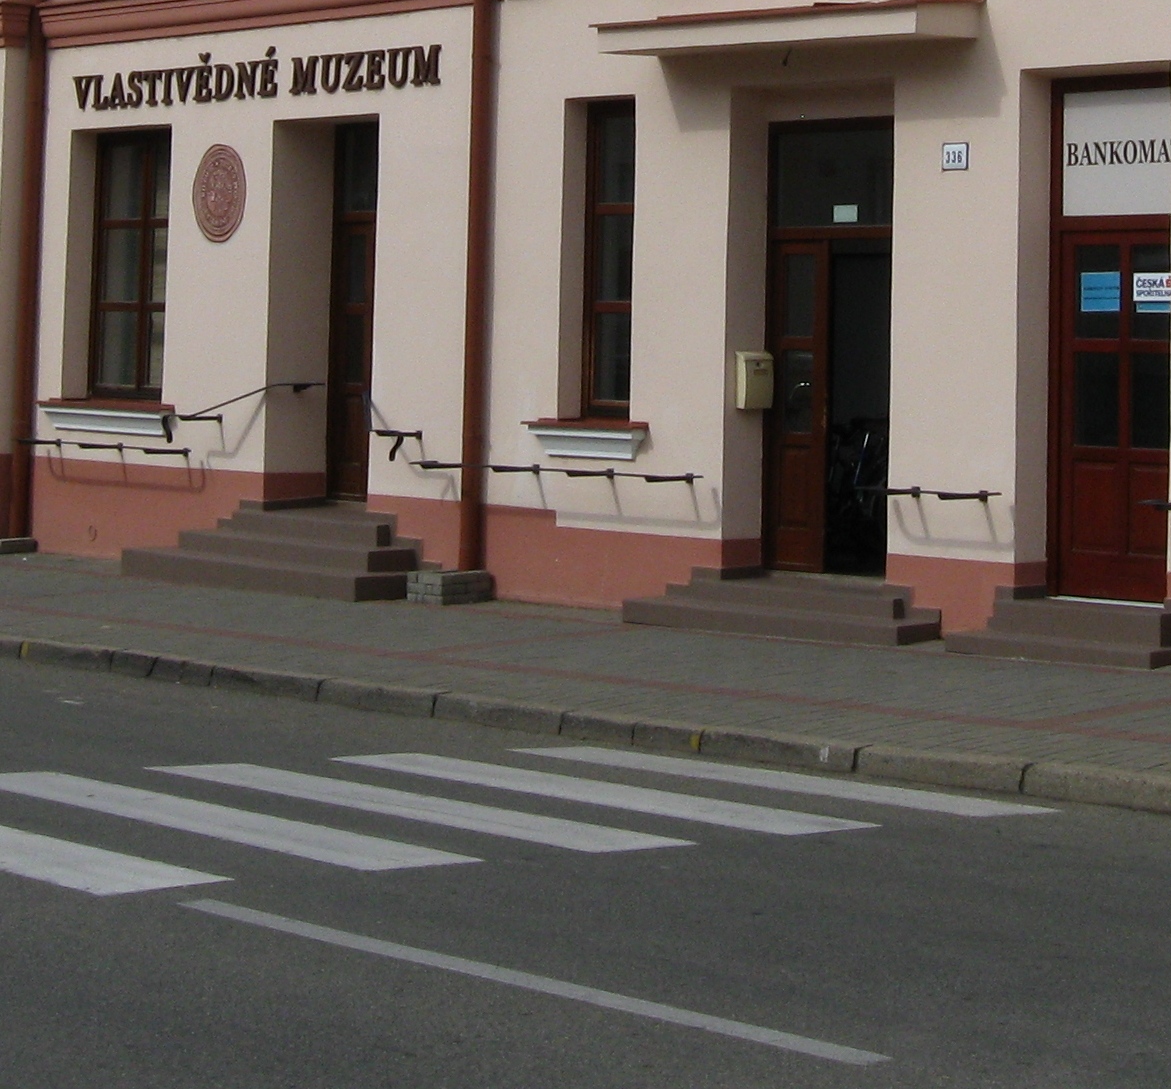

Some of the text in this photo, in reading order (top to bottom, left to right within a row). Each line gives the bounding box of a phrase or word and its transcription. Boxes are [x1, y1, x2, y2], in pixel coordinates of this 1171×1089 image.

[73, 44, 442, 111] VLASTIVĚDNÉ MUZEUM
[1136, 276, 1165, 288] ČESKÁ
